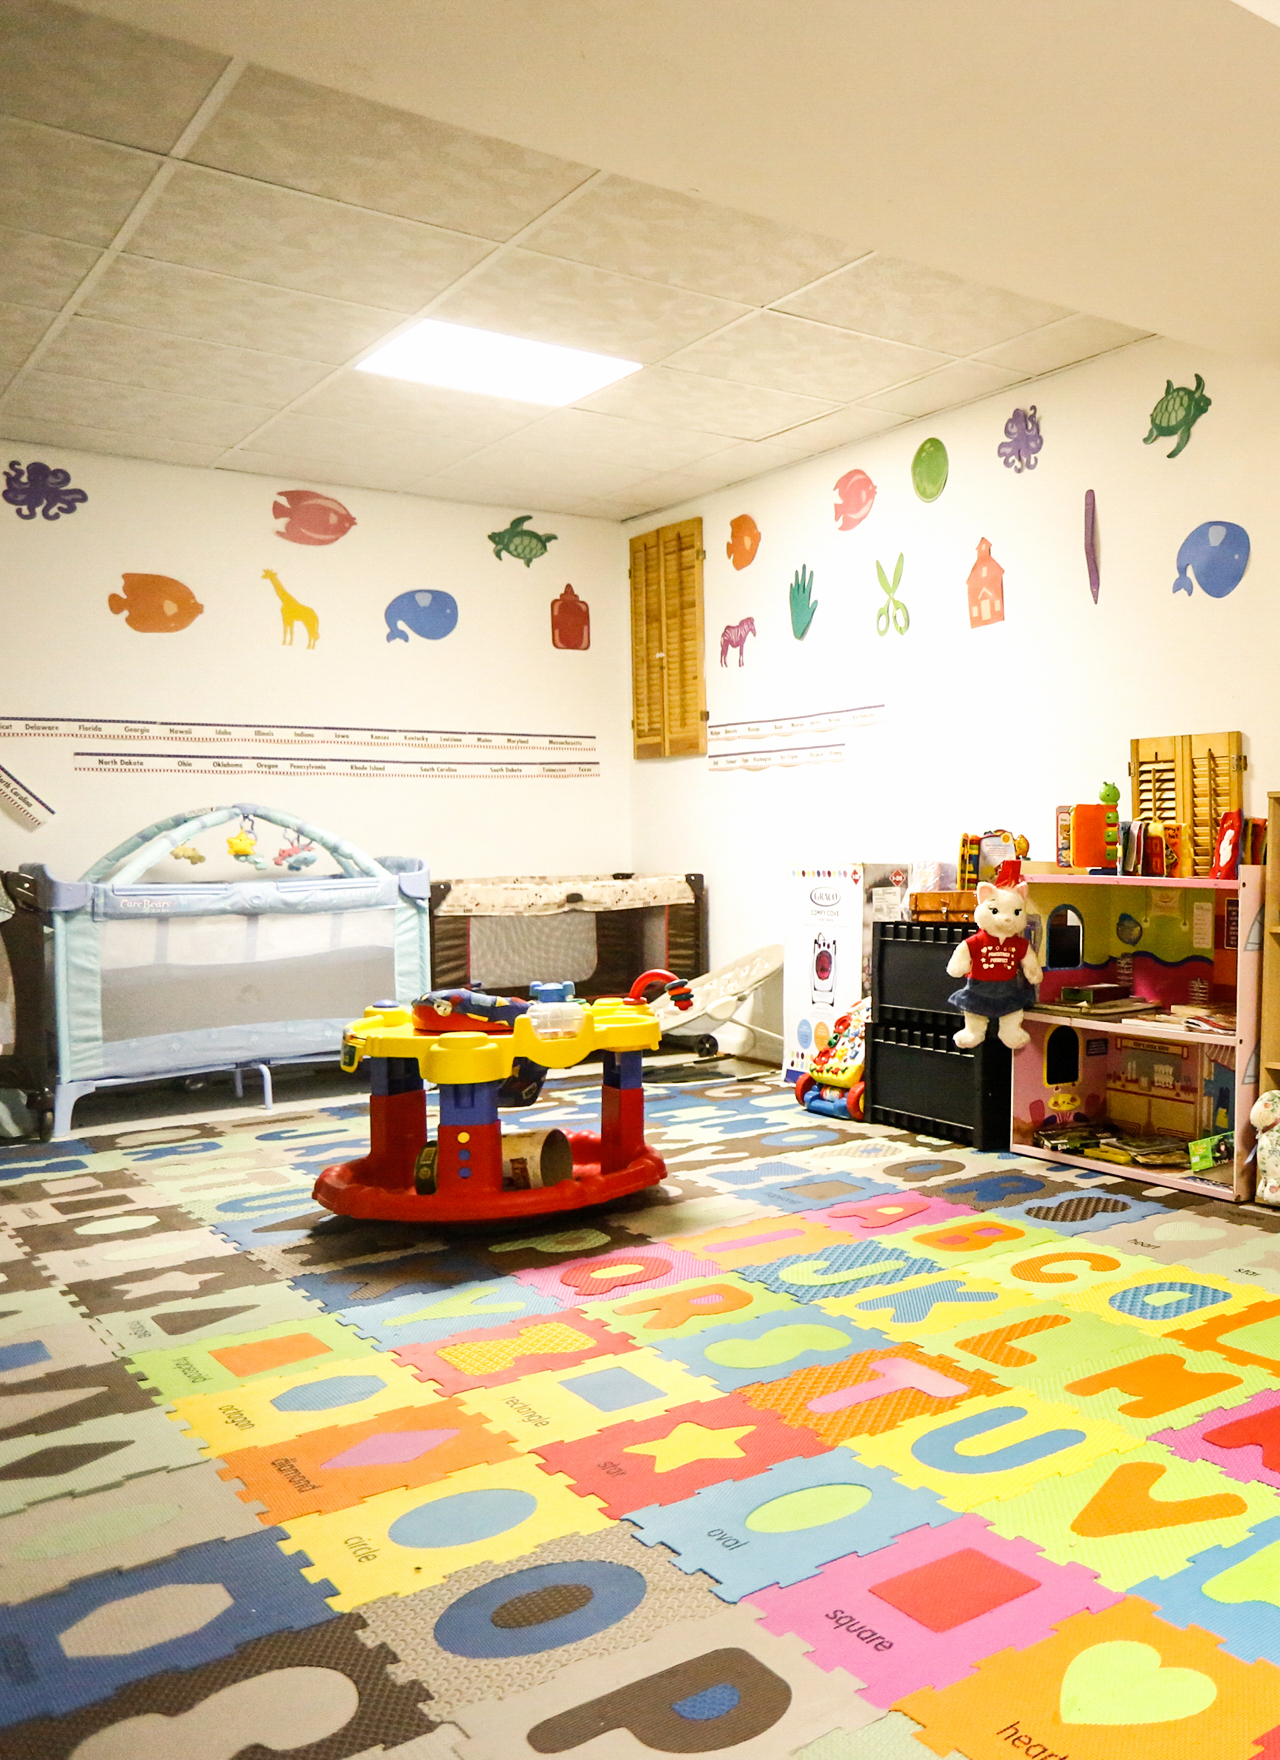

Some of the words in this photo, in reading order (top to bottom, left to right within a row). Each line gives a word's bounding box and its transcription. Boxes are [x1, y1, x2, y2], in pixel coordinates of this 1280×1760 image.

[78, 724, 103, 732] Florida
[913, 1221, 1026, 1252] B
[1010, 1251, 1121, 1284] C
[779, 1259, 907, 1287] J
[855, 1280, 999, 1323] K
[954, 1314, 1071, 1367] L
[501, 1395, 551, 1428] rectangle
[613, 1283, 754, 1330] R
[704, 1323, 852, 1369] S
[806, 1357, 969, 1413] T
[910, 1405, 1087, 1475] U
[1070, 1461, 1248, 1538] V
[343, 1535, 380, 1563] circle
[706, 1527, 750, 1551] oval
[824, 1608, 894, 1653] square
[526, 1646, 792, 1754] P
